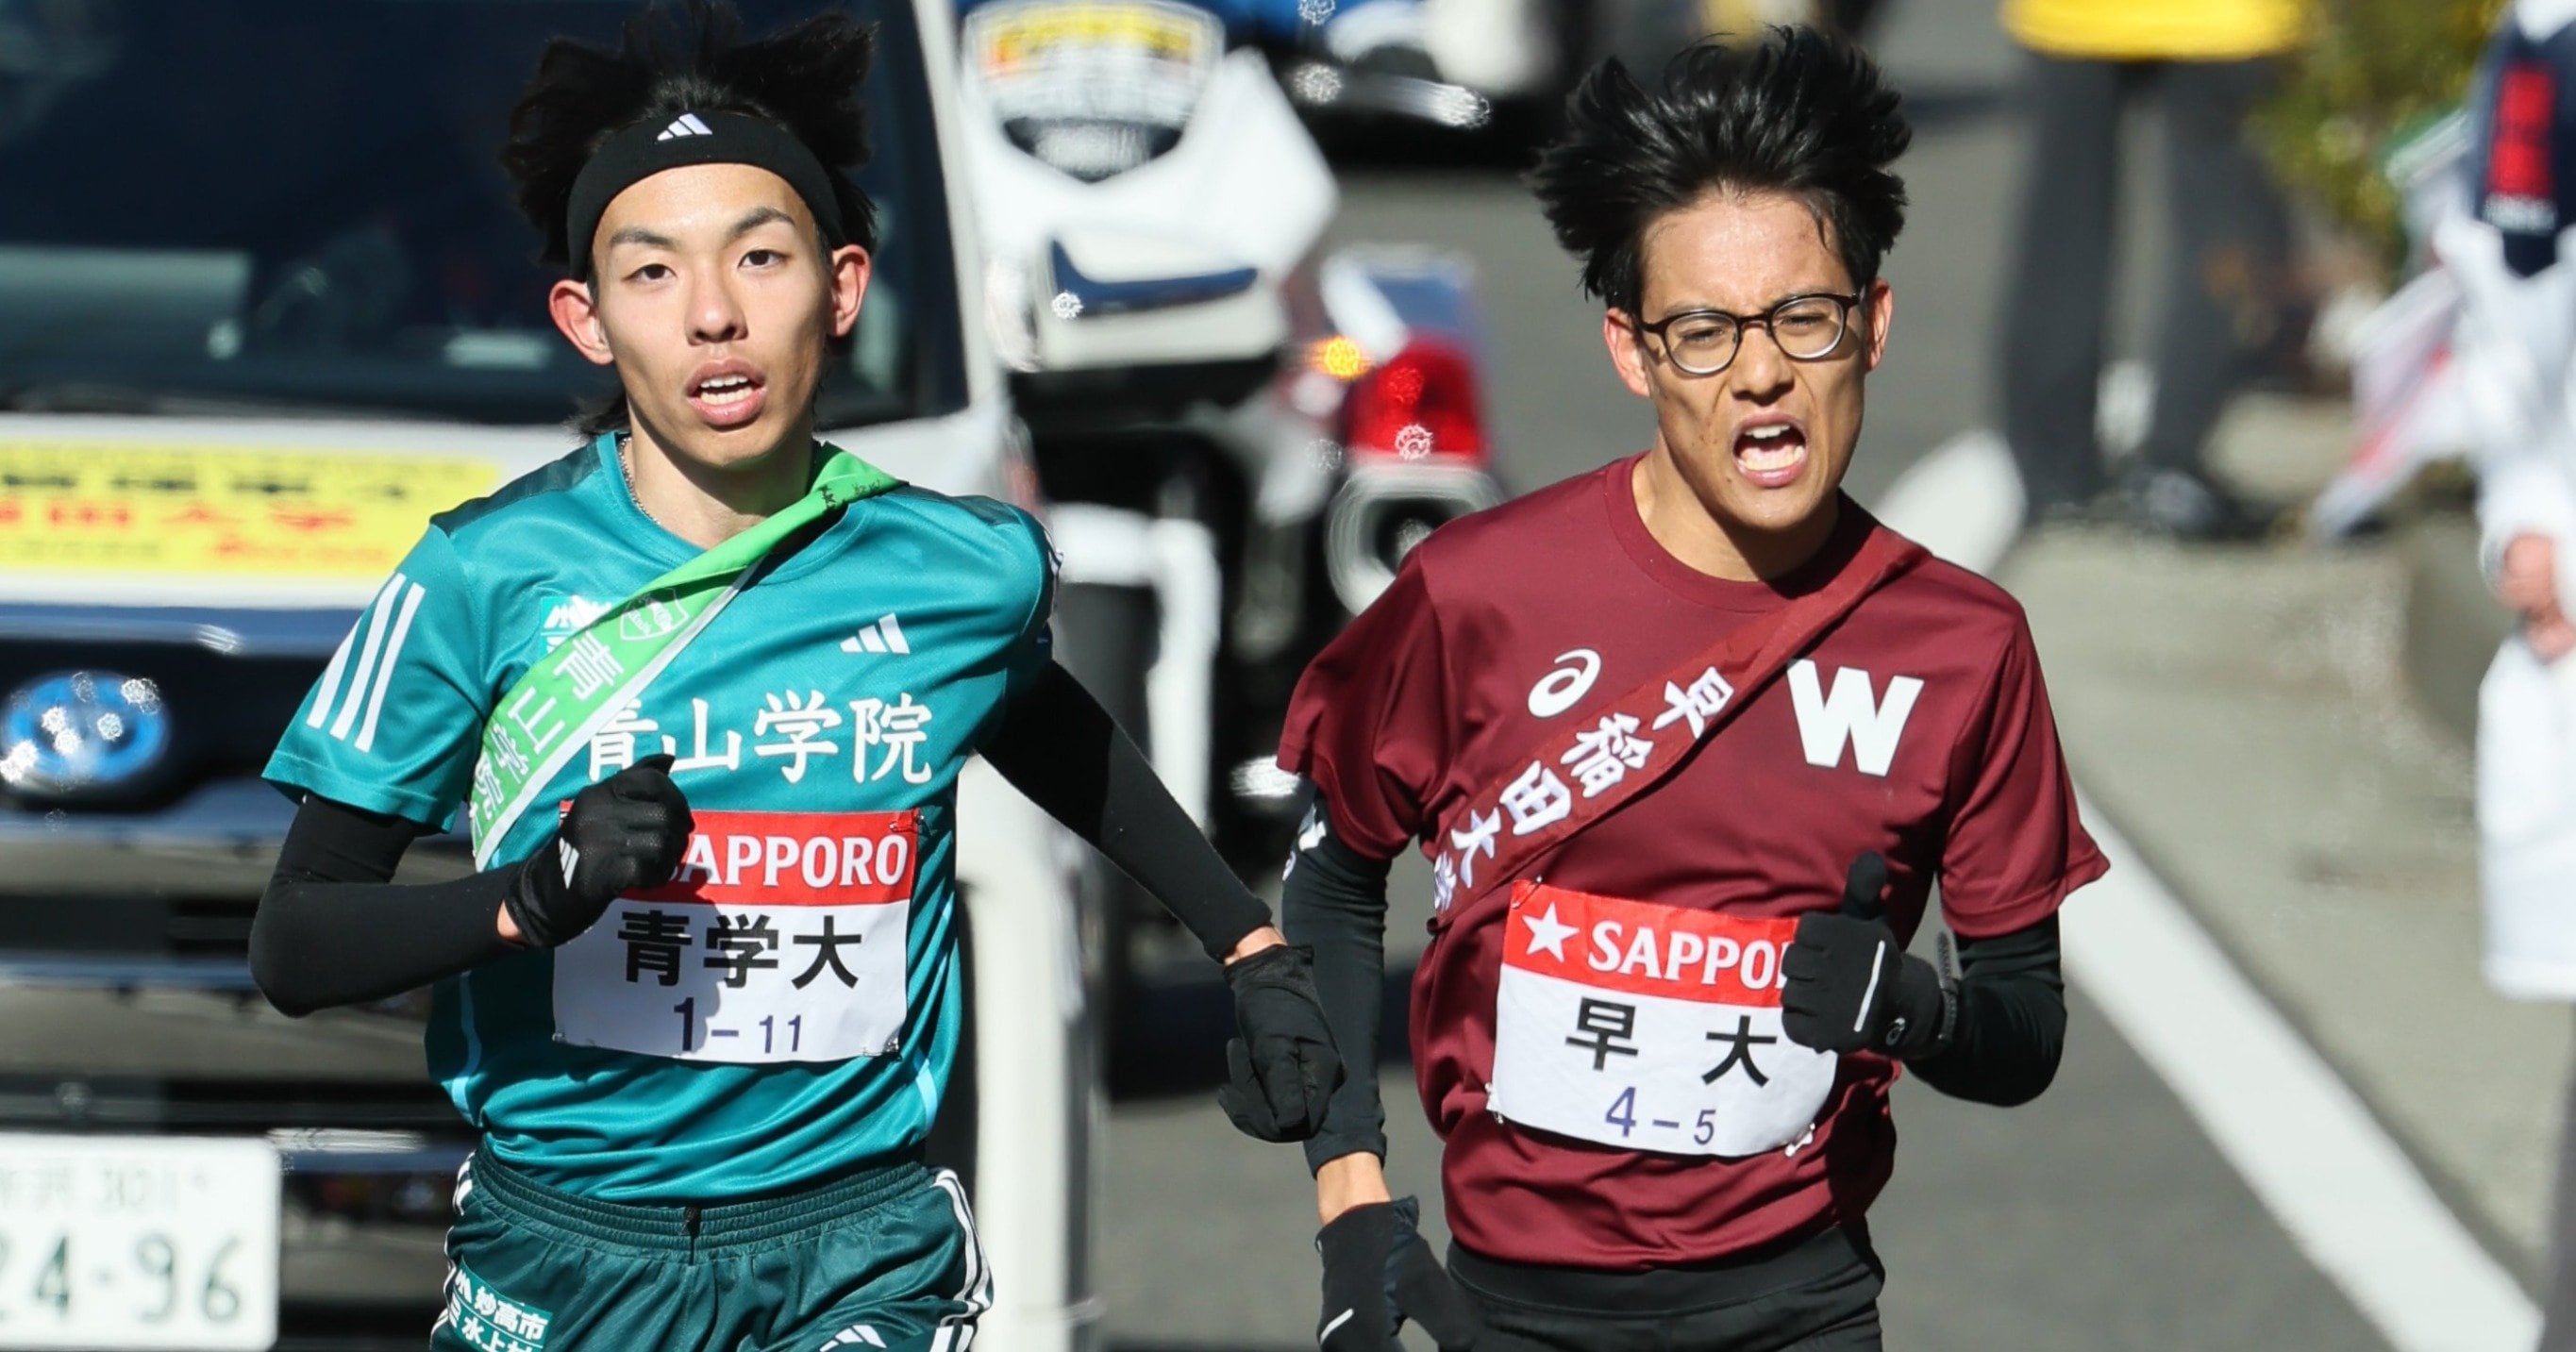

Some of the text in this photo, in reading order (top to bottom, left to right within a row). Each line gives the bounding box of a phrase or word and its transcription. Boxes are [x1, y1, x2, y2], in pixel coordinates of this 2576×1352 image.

[588, 689, 932, 785] 青山学院
[1786, 659, 1924, 777] W
[669, 834, 907, 888] APPORO
[617, 910, 862, 990] 青学大
[1588, 920, 1795, 991] SAPPO
[474, 1286, 548, 1341] 妙高市
